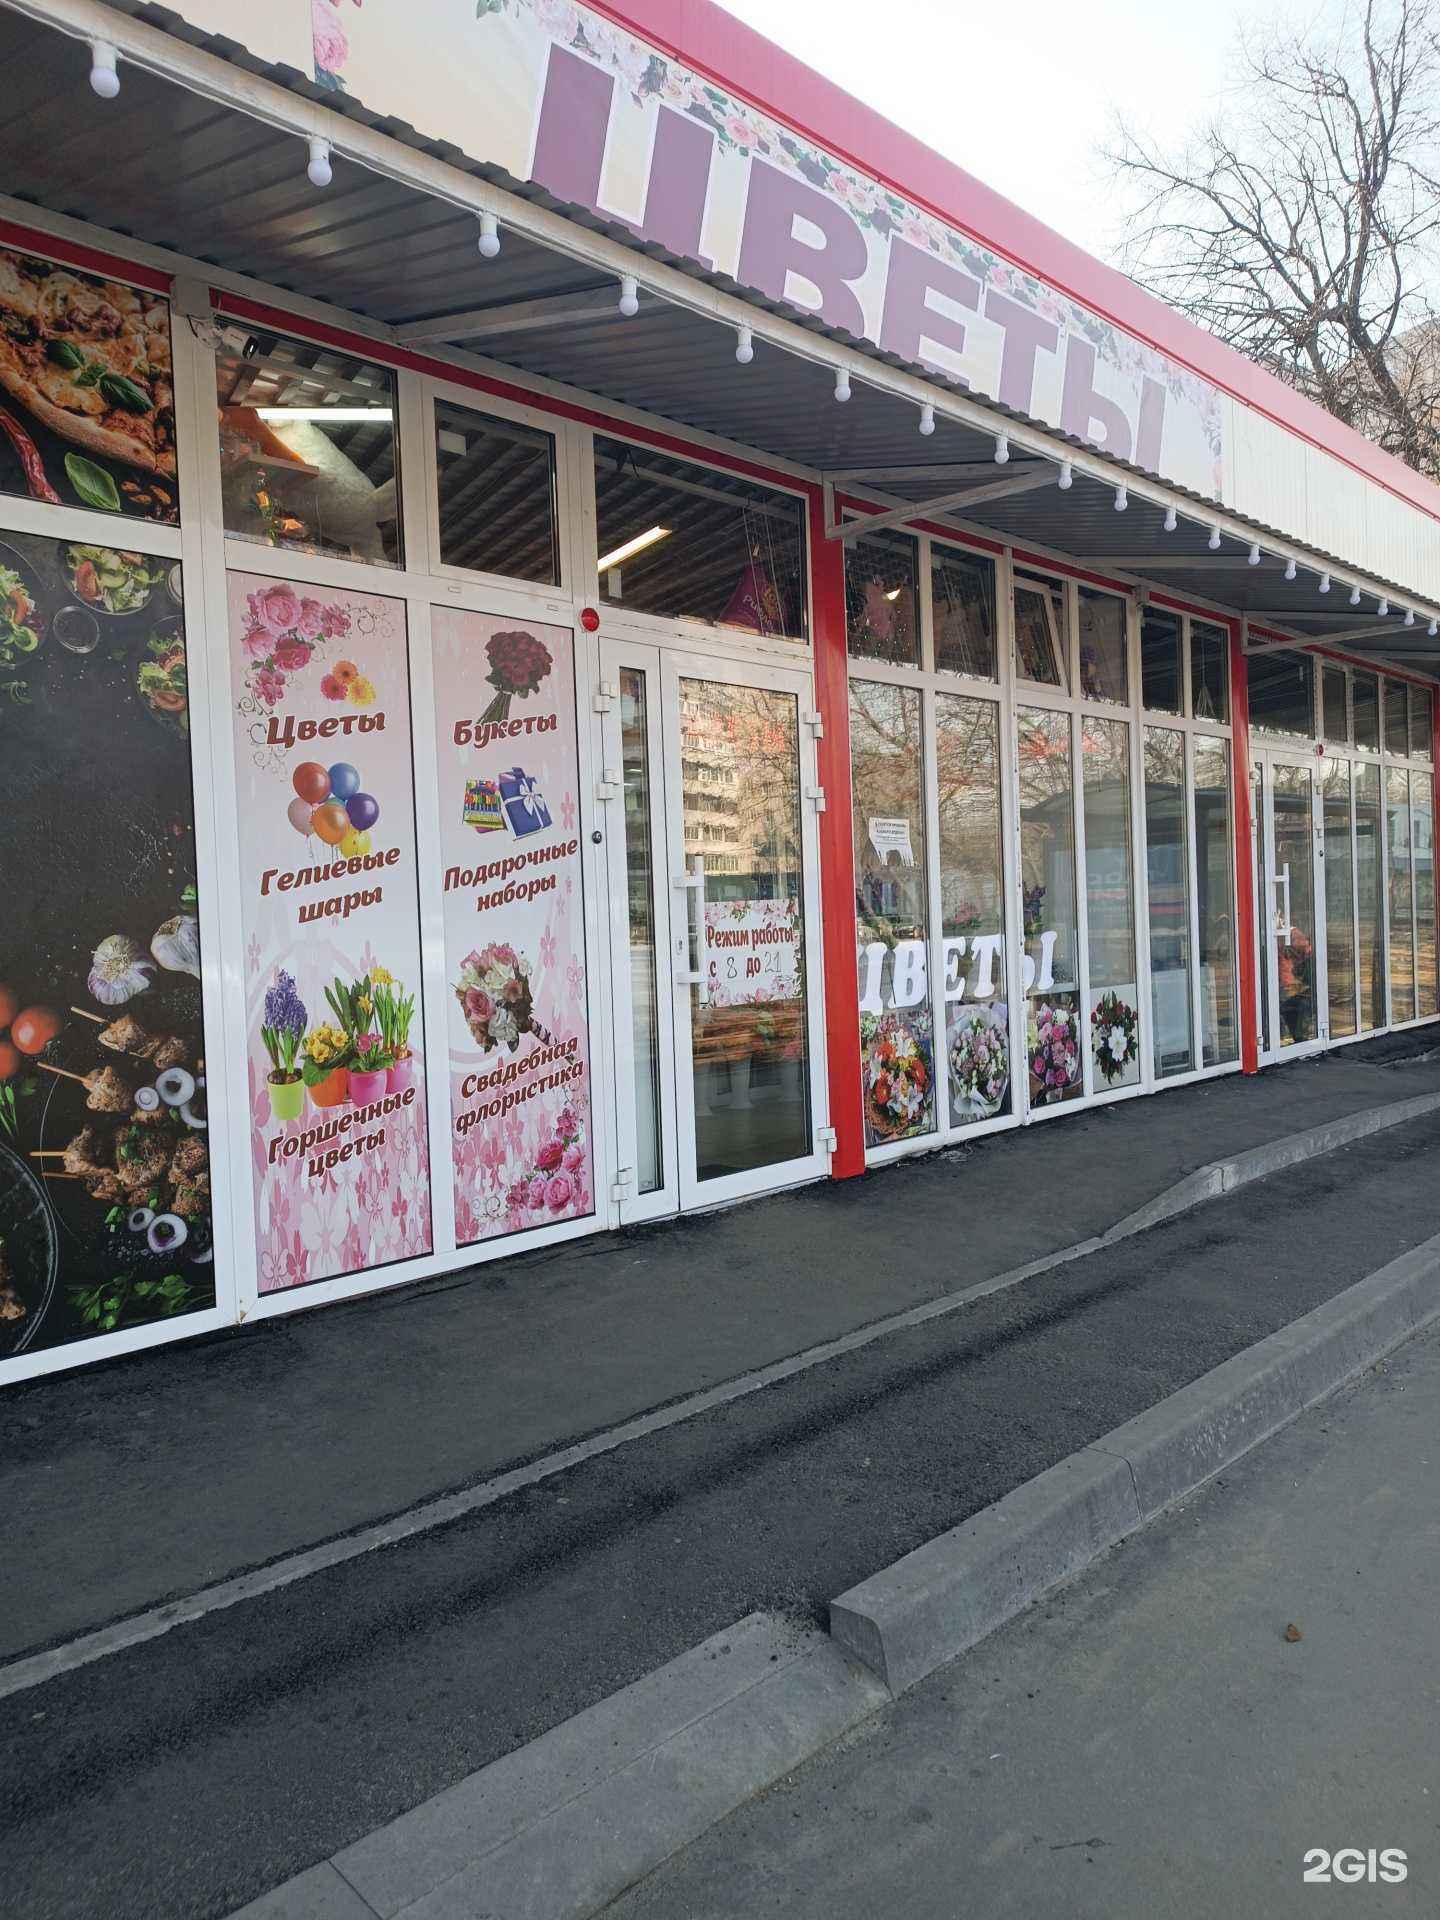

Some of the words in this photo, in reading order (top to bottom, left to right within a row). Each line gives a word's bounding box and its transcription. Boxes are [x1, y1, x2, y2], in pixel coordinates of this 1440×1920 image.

[529, 41, 1167, 475] ЦВЕТЫ
[266, 711, 386, 749] Цветы
[453, 712, 558, 749] Букеты
[260, 847, 401, 897] Гелиевые
[443, 838, 578, 892] Подарочные
[298, 886, 383, 924] шары
[476, 873, 557, 912] наборы
[707, 925, 749, 949] Режим
[751, 922, 794, 950] работы
[709, 960, 717, 977] с
[726, 956, 738, 979] 8
[746, 956, 761, 978] до
[764, 951, 782, 973] 21
[460, 1037, 579, 1099] Свадебная
[455, 1060, 584, 1136] флористика
[267, 1087, 416, 1165] Горшечные
[308, 1128, 386, 1178] цветы
